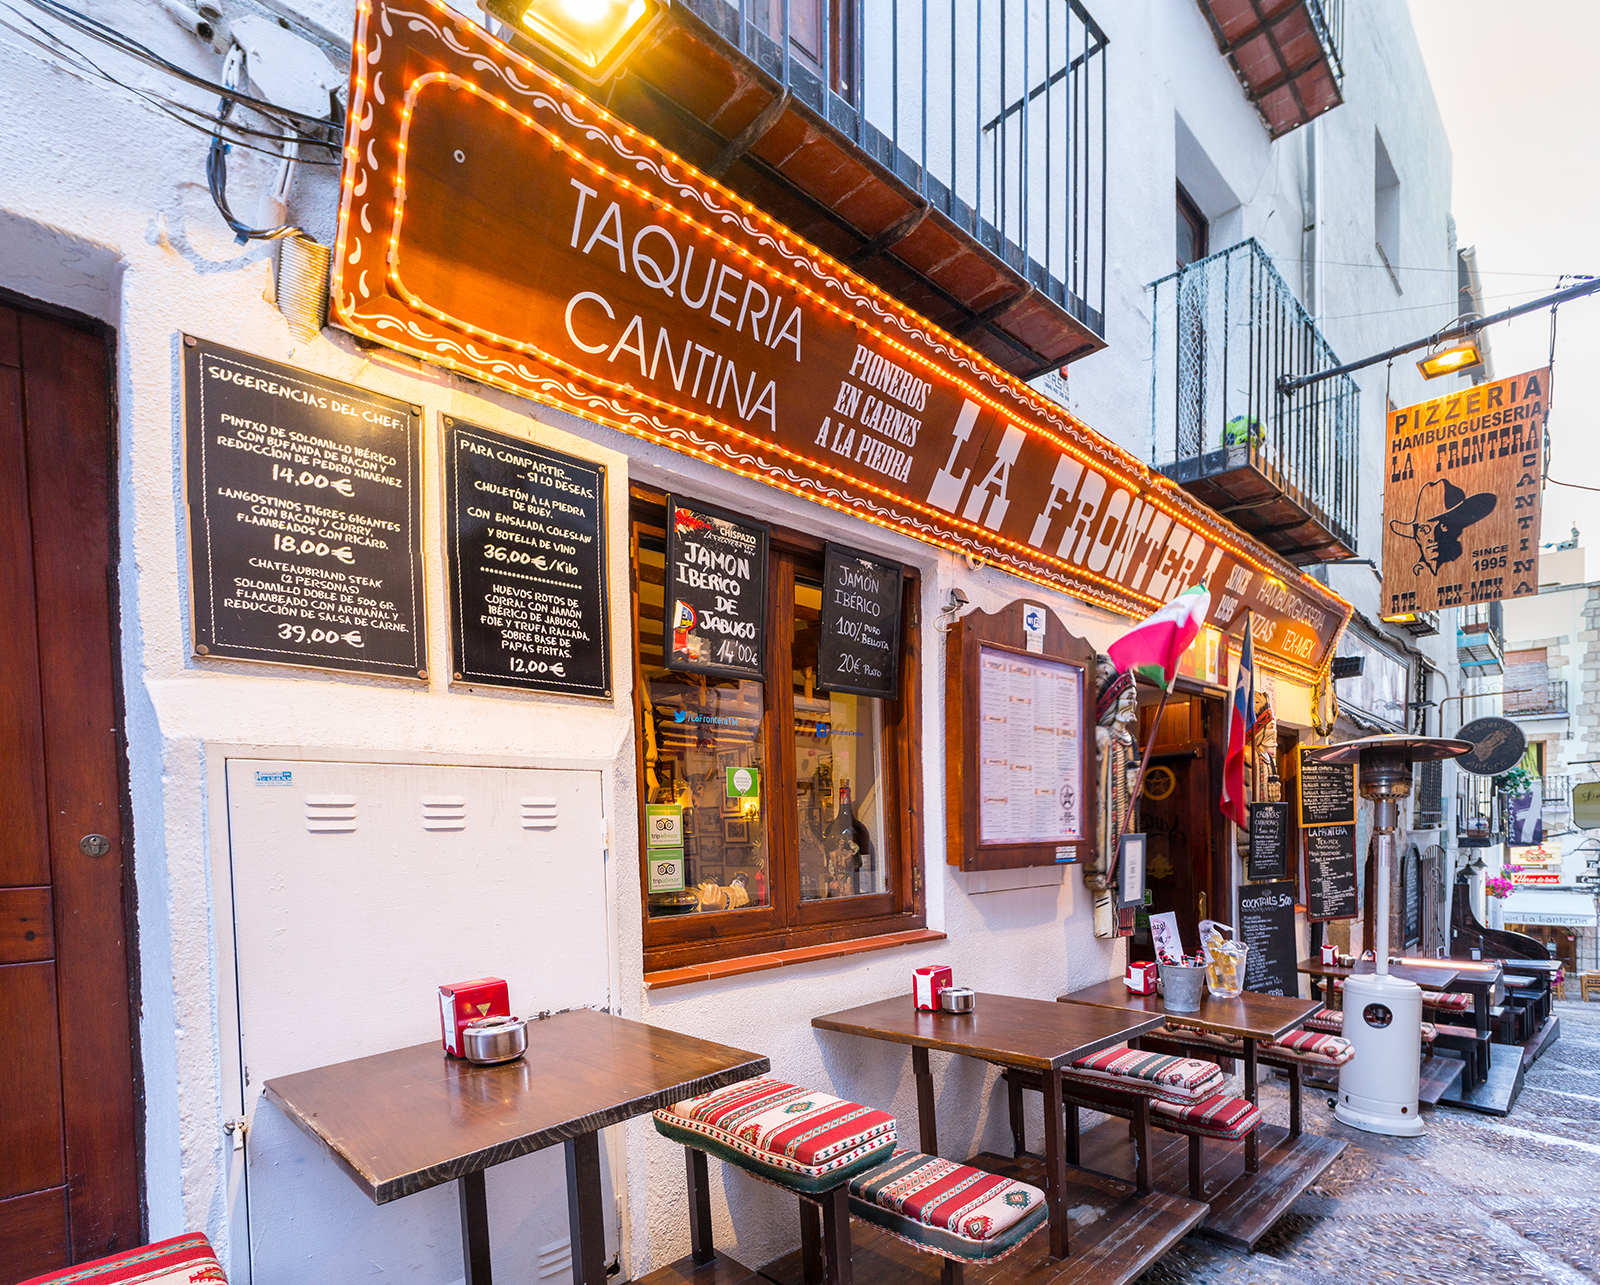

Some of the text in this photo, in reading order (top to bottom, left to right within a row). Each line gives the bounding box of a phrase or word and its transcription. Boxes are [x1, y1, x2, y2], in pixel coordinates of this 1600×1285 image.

[570, 178, 802, 362] TAQUERIA
[564, 290, 777, 432] CANTINA
[848, 344, 932, 412] PIONEROS
[208, 366, 404, 431] SUGERENCIAS DEL CHEF:
[833, 380, 922, 448] EN CARNES
[1395, 375, 1542, 435] PIZZERIA
[221, 413, 396, 466] PINTXO DE SOLOMILLO IBÉRICO
[1392, 400, 1542, 453] HAMBURGUESERIA
[237, 430, 386, 474] CON BUFANDA DE BACON Y
[460, 440, 572, 480] PARA COMPARTIR...
[814, 416, 913, 484] A LA PIEDRA
[1392, 420, 1538, 483] LA FRONTERA
[272, 464, 354, 497] 14,00€
[294, 454, 310, 465] DE
[313, 458, 351, 475] PEDRO
[354, 468, 402, 488] XIMENEZ
[527, 472, 538, 483] SI
[540, 476, 552, 486] LO
[555, 479, 595, 499] DESEAS.
[218, 488, 401, 532] LANGOSTINOS TIGRES GIGANTES
[474, 480, 586, 518] CHULETÓN A LA PIEDRA
[512, 500, 554, 518] DE BUEY.
[926, 397, 1224, 601] LA FRONTERA
[236, 512, 388, 550] FLAMBEADOS CON RICARD.
[251, 505, 278, 518] CON
[280, 508, 319, 526] BACON
[322, 518, 328, 528] Y
[467, 507, 592, 544] CON ENSALADA COLESLAW
[1513, 452, 1536, 594] CANTINA
[274, 533, 356, 564] 18,00€
[488, 527, 576, 556] Y BOTELLA DE VINO
[720, 528, 756, 544] CHISPAZO
[1472, 544, 1508, 558] SINCE
[249, 557, 384, 588] CHATEAUBRIAND STEAK
[1472, 555, 1507, 572] 1995
[234, 578, 396, 611] SOLOMILLO DOBLE DE 500 GR.
[281, 573, 360, 594] (2 PERSONAS)
[1225, 564, 1254, 596] SINCE
[1391, 577, 1503, 613] RTE. TEX-MEX
[236, 589, 398, 620] FLAMBEADO CON ARMAÑAL Y
[485, 594, 582, 620] CORRAL CON JAMÓN
[492, 584, 579, 608] HUEVOS ROTOS DE
[714, 596, 738, 616] DE
[834, 589, 880, 616] IBÉRICO
[1256, 579, 1326, 632] HAMBURGUESERIA
[224, 598, 409, 632] REDUCCIÓN DE SALSA DE CARNE.
[480, 615, 503, 626] FOIE
[506, 620, 512, 628] Y
[514, 621, 547, 635] TRUFA
[488, 604, 527, 619] IBÉRICO
[530, 612, 542, 622] DE
[699, 610, 756, 640] JABUGO
[278, 622, 364, 648] 39,00€
[501, 630, 572, 648] SOBRE BASE DE
[836, 616, 880, 642] 100% PURO
[861, 634, 889, 650] BELLOTA
[1281, 629, 1316, 660] TEX-MEX
[502, 640, 572, 658] PAPAS FRITAS.
[838, 653, 862, 675] 20€
[510, 657, 566, 678] 12,00€
[688, 714, 738, 726] /LaFronteraTM
[1318, 826, 1348, 836] FRONTERA
[1242, 896, 1278, 908] COCKTAILS
[1539, 916, 1588, 924] Lanterna
